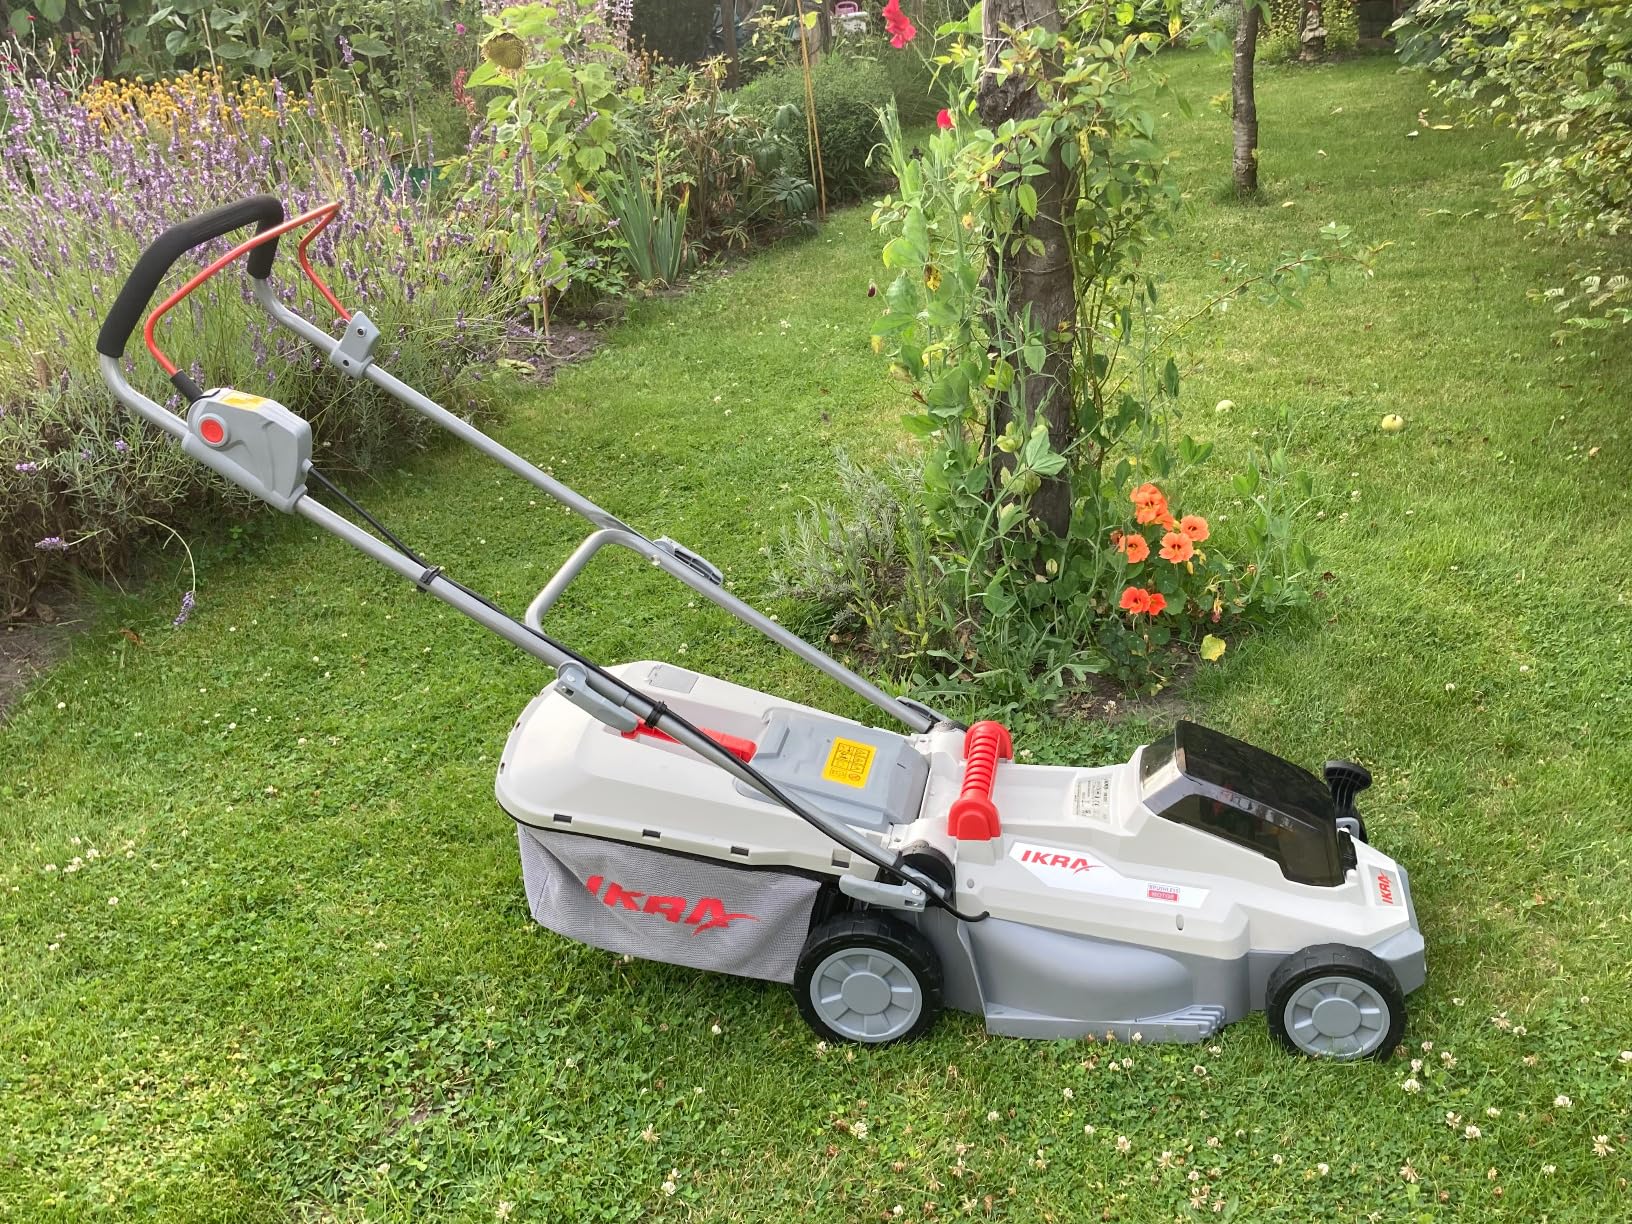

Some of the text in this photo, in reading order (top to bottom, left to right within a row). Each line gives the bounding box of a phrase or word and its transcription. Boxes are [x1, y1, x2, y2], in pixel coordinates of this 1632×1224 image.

[1021, 850, 1104, 874] IKRA
[1378, 871, 1393, 904] IKRA
[585, 875, 760, 937] IKRA
